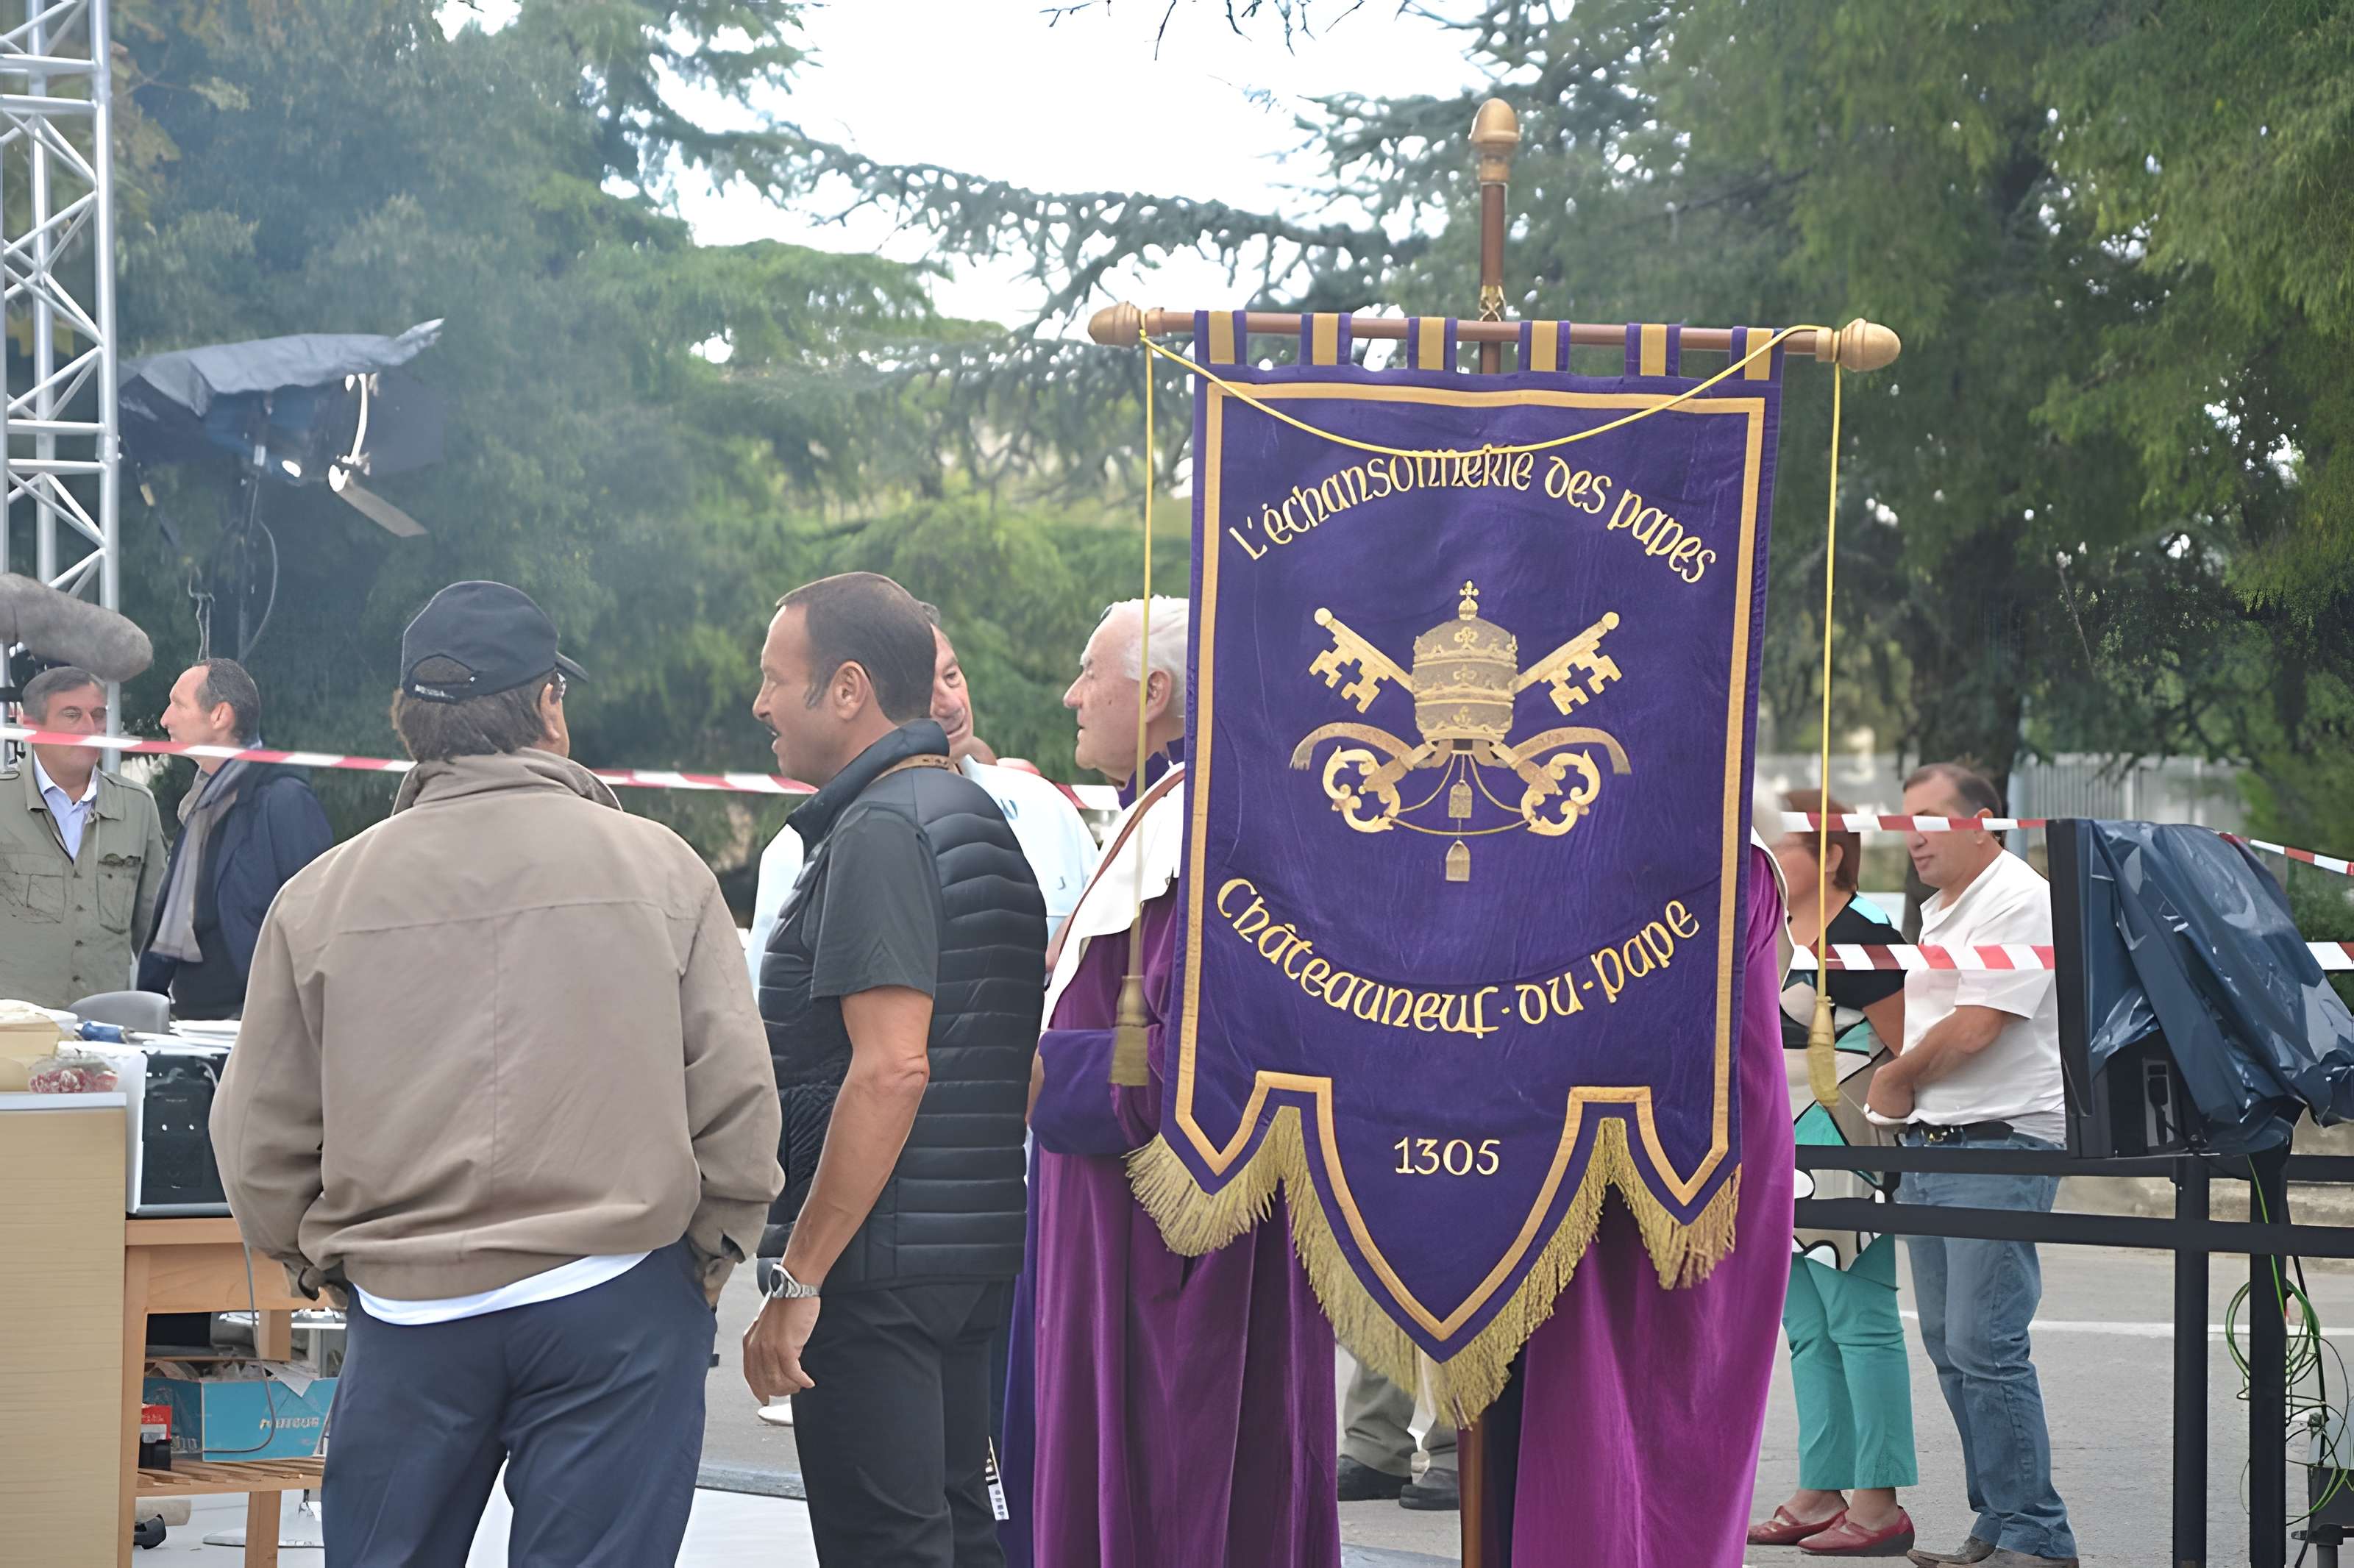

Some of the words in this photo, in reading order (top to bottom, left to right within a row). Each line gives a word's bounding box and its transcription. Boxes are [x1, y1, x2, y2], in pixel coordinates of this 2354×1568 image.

[1544, 455, 1613, 515] des
[1607, 488, 1717, 584] papes
[1393, 1136, 1501, 1177] 1305
